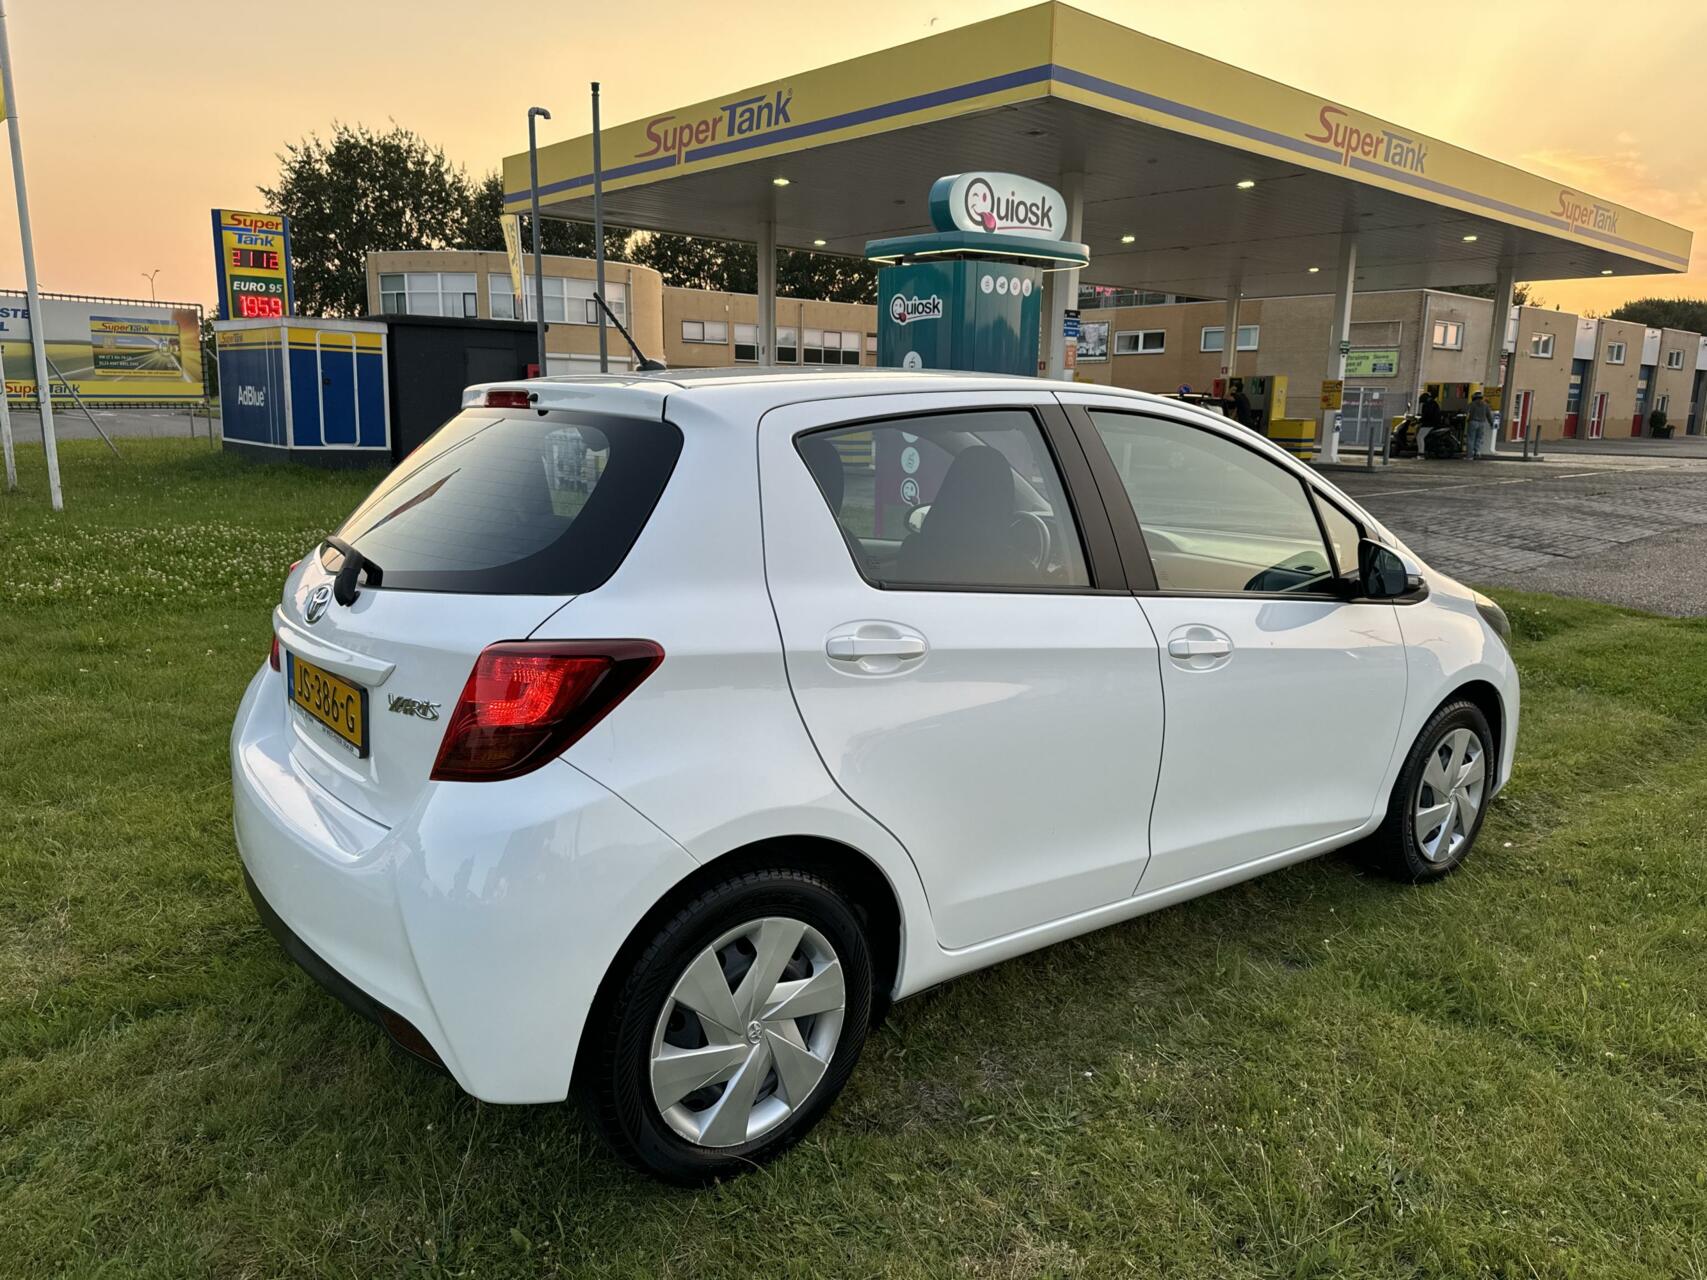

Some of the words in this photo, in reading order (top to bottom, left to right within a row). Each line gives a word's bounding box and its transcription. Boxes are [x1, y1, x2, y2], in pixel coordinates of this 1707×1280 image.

[1304, 105, 1428, 174] SuperTank
[964, 177, 1053, 233] Quiosk
[1550, 189, 1619, 233] SuperTank
[222, 213, 282, 234] Super
[232, 232, 275, 247] Tank
[232, 281, 266, 292] EURO
[268, 283, 283, 293] 95
[891, 296, 941, 324] Quiosk
[238, 385, 266, 407] AdBlue
[297, 662, 356, 734] JS-386-G
